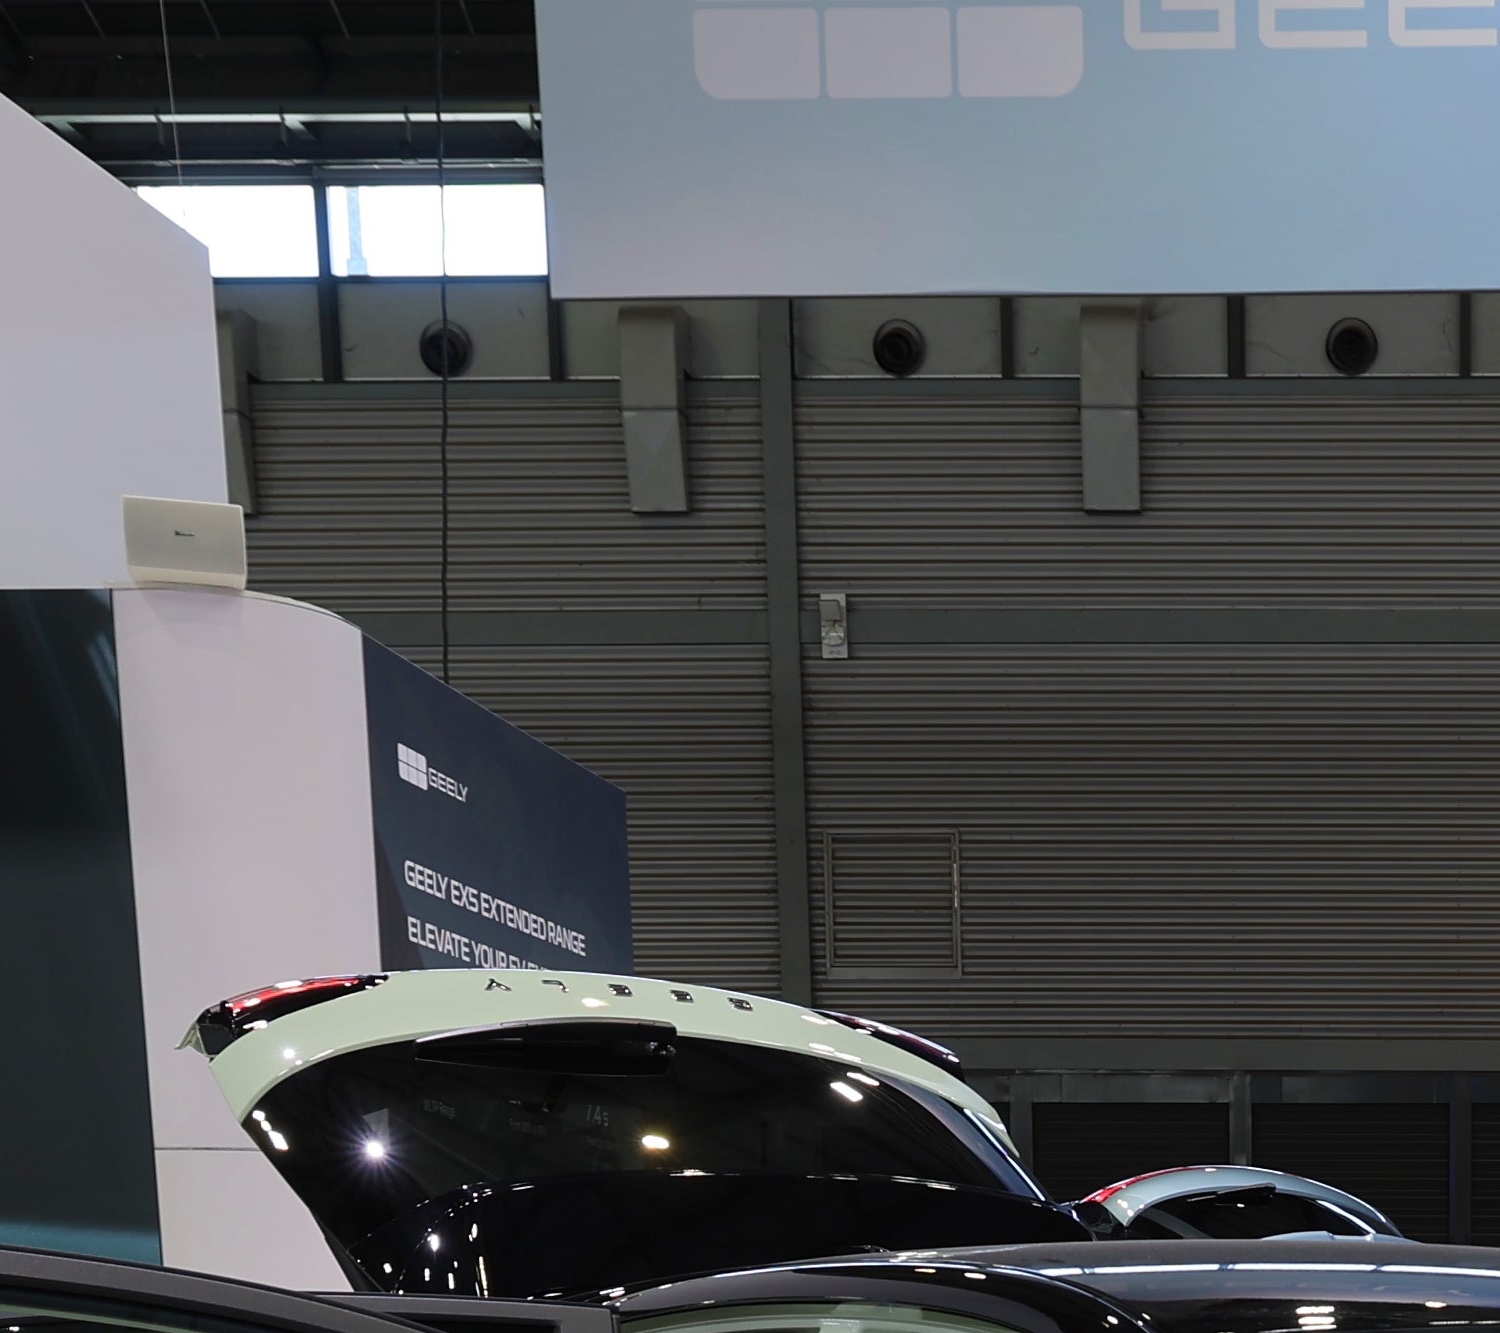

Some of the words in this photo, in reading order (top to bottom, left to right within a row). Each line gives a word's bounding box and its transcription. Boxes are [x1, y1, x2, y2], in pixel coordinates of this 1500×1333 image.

[428, 767, 468, 802] GEELY
[404, 859, 448, 900] GEELY
[450, 879, 479, 913] EX5
[480, 892, 547, 941] EXTENDED
[547, 920, 587, 957] RANGE
[406, 915, 471, 963] ELEVATE
